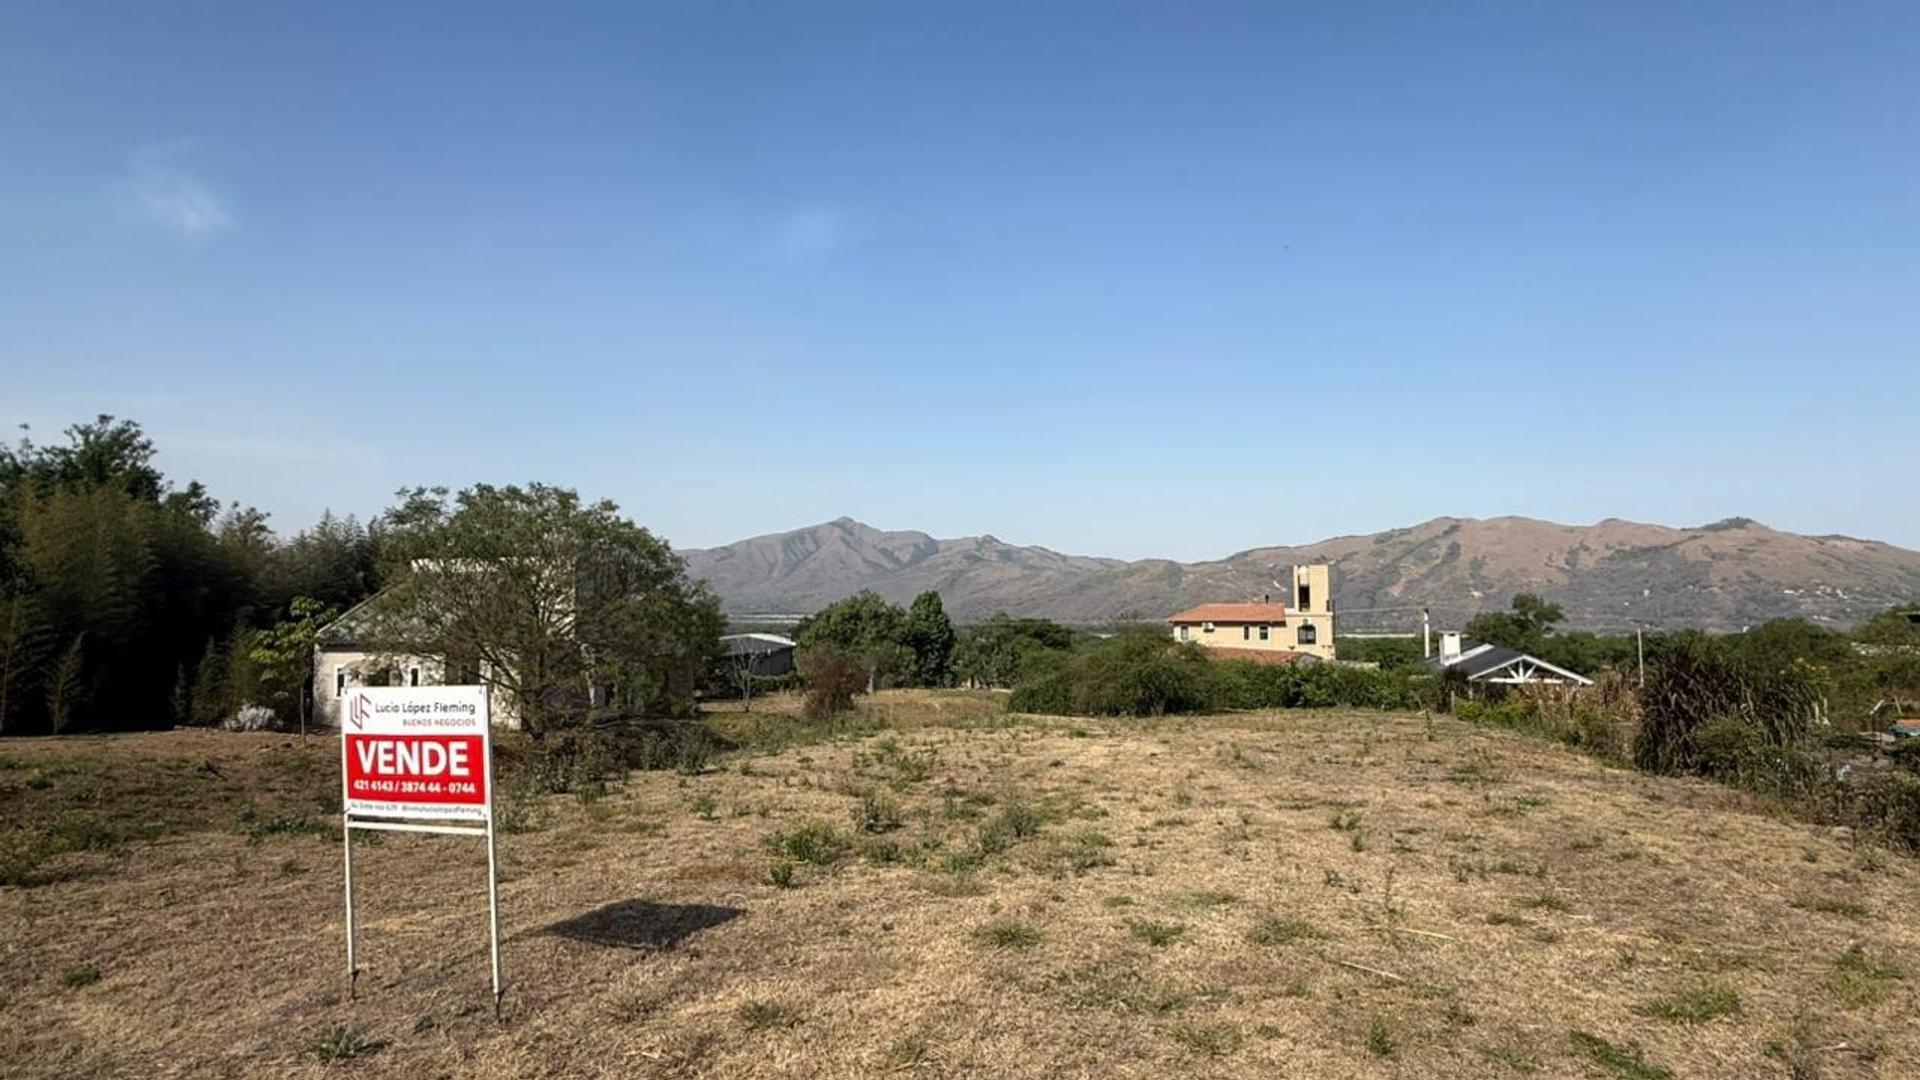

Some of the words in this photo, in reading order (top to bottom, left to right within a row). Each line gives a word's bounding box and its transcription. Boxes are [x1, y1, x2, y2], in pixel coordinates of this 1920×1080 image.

[402, 701, 431, 715] López
[433, 700, 476, 715] Fleming
[434, 718, 476, 726] NEGOCIOS
[356, 740, 470, 776] VENDE
[354, 780, 369, 790] 421
[371, 781, 394, 792] 4143
[401, 782, 426, 793] 3874
[427, 783, 441, 793] 44
[448, 783, 476, 794] 0744
